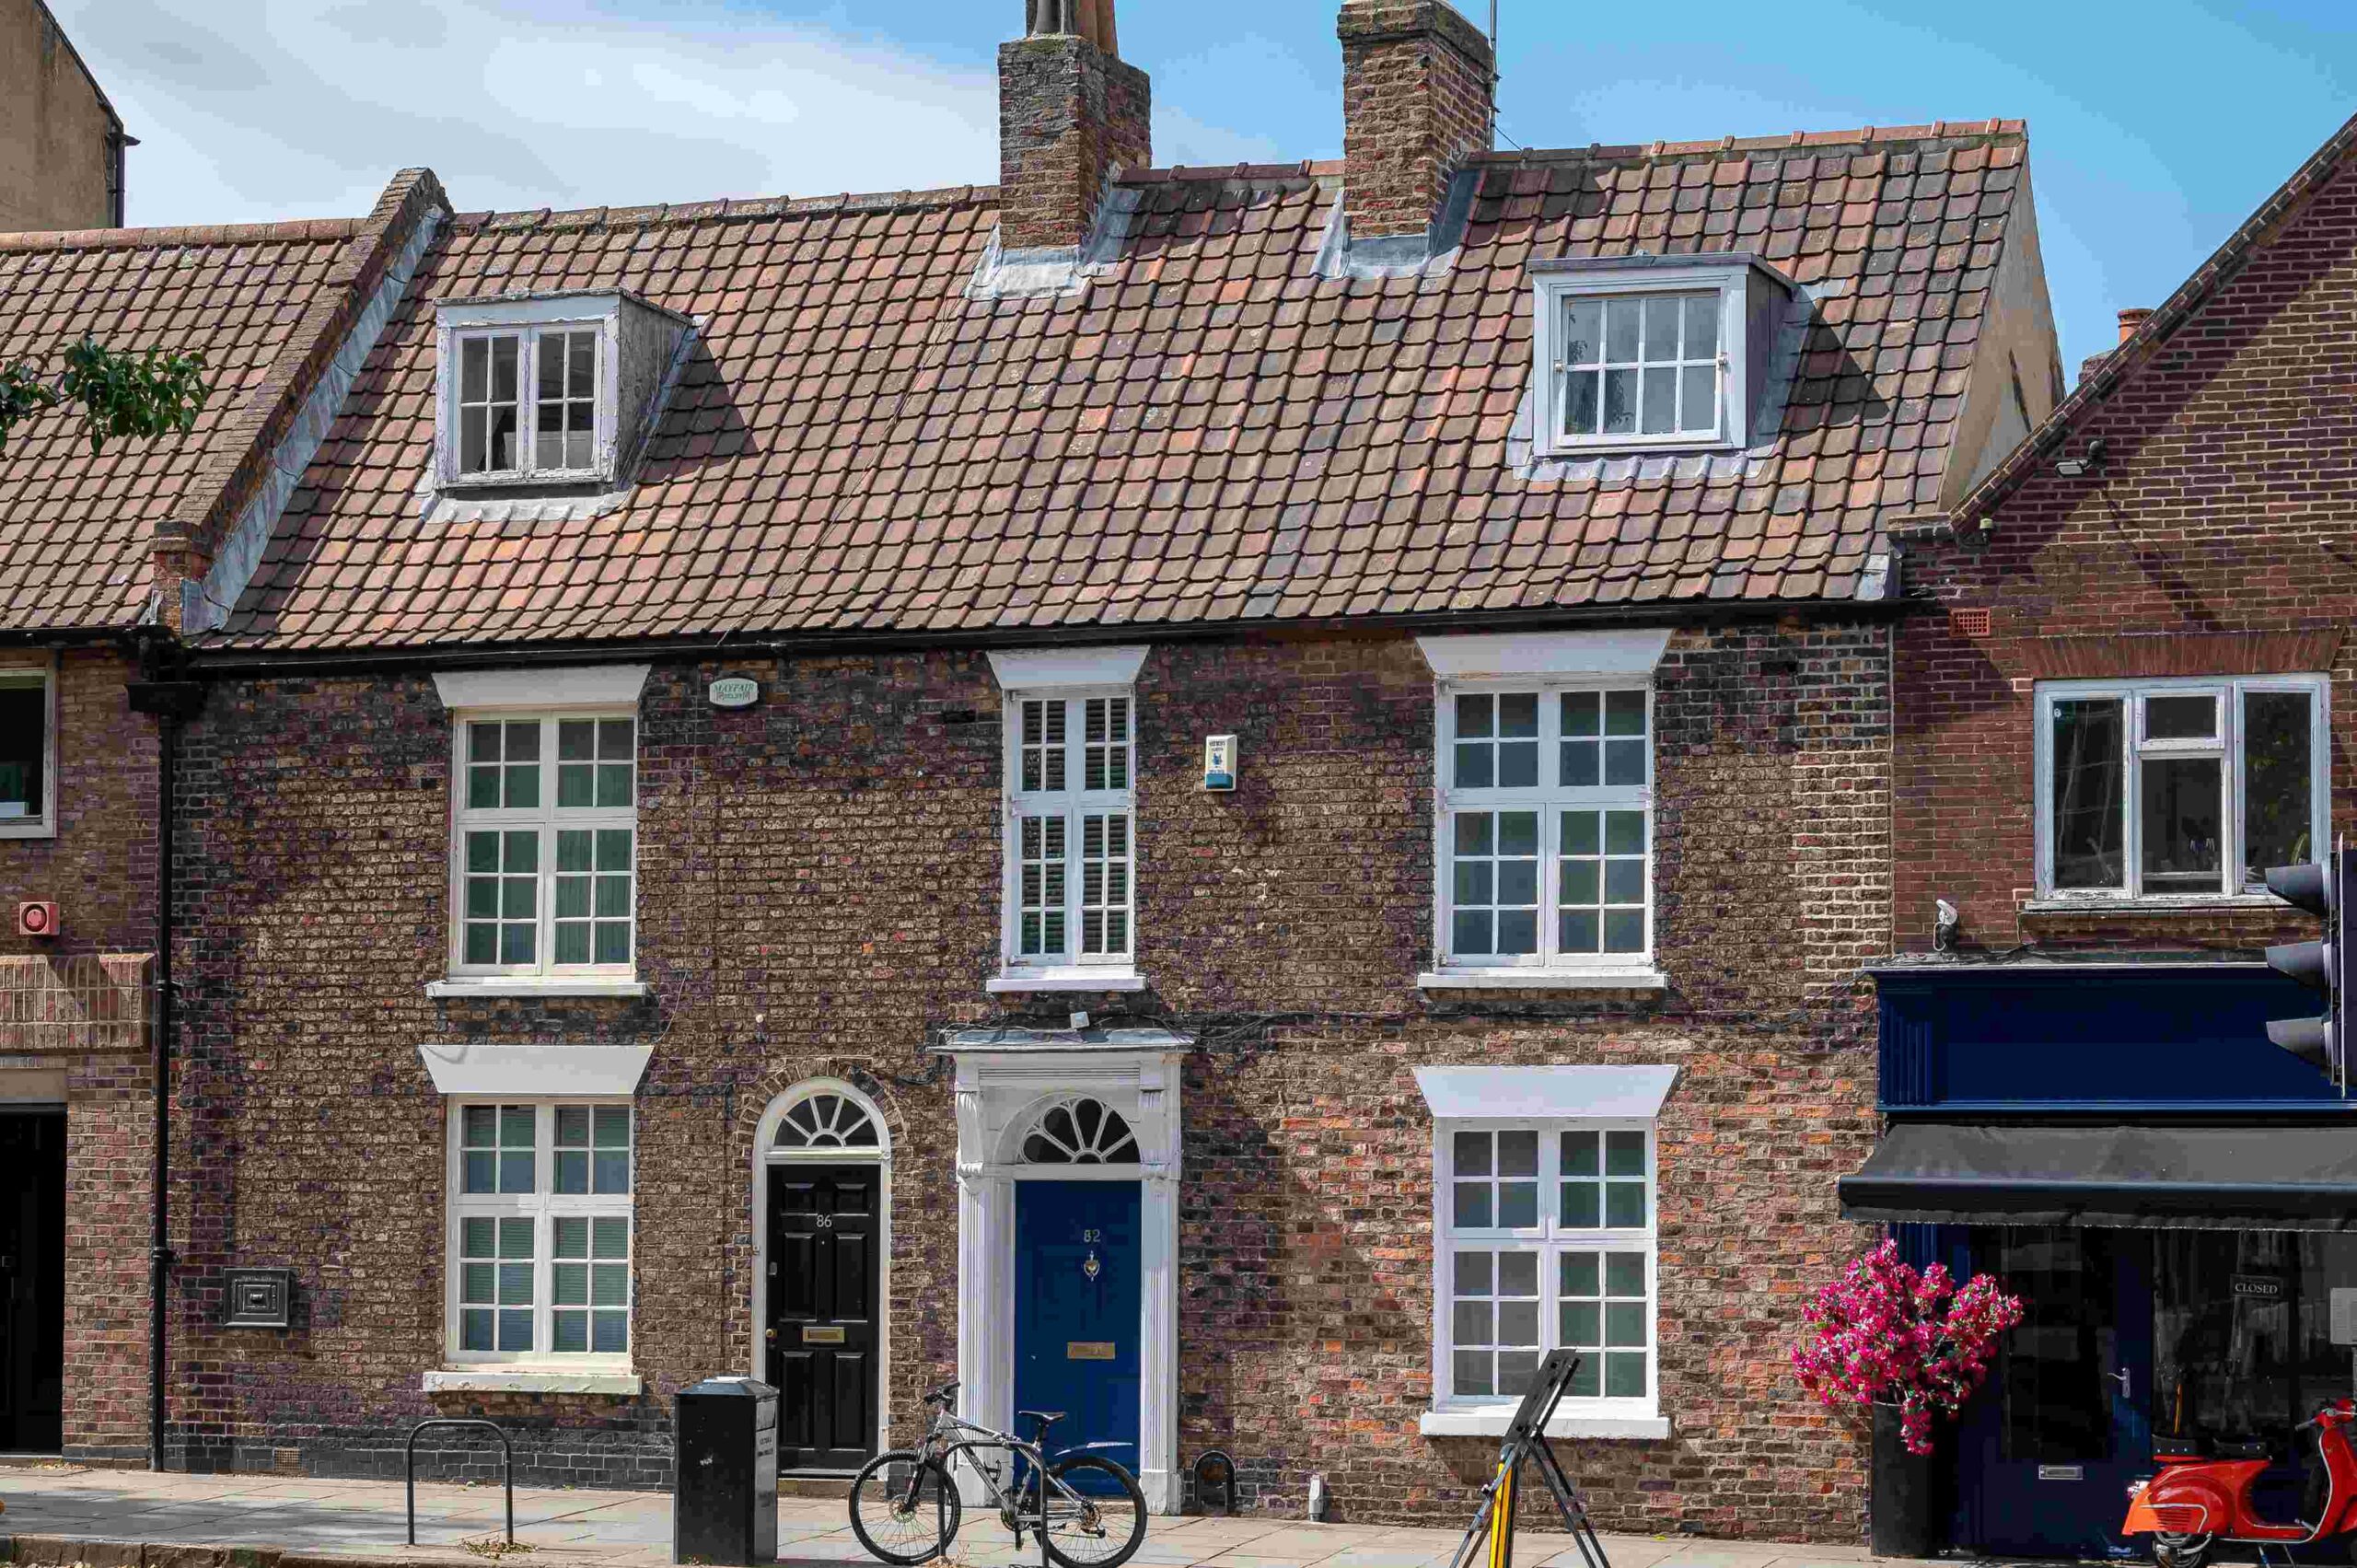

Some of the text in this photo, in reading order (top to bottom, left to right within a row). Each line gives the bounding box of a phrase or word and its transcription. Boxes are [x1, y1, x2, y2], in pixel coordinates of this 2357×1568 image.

[714, 682, 755, 692] MAYFAIR
[816, 1214, 832, 1228] 86
[1083, 1228, 1101, 1243] 82
[2235, 1283, 2278, 1295] CLOSED
